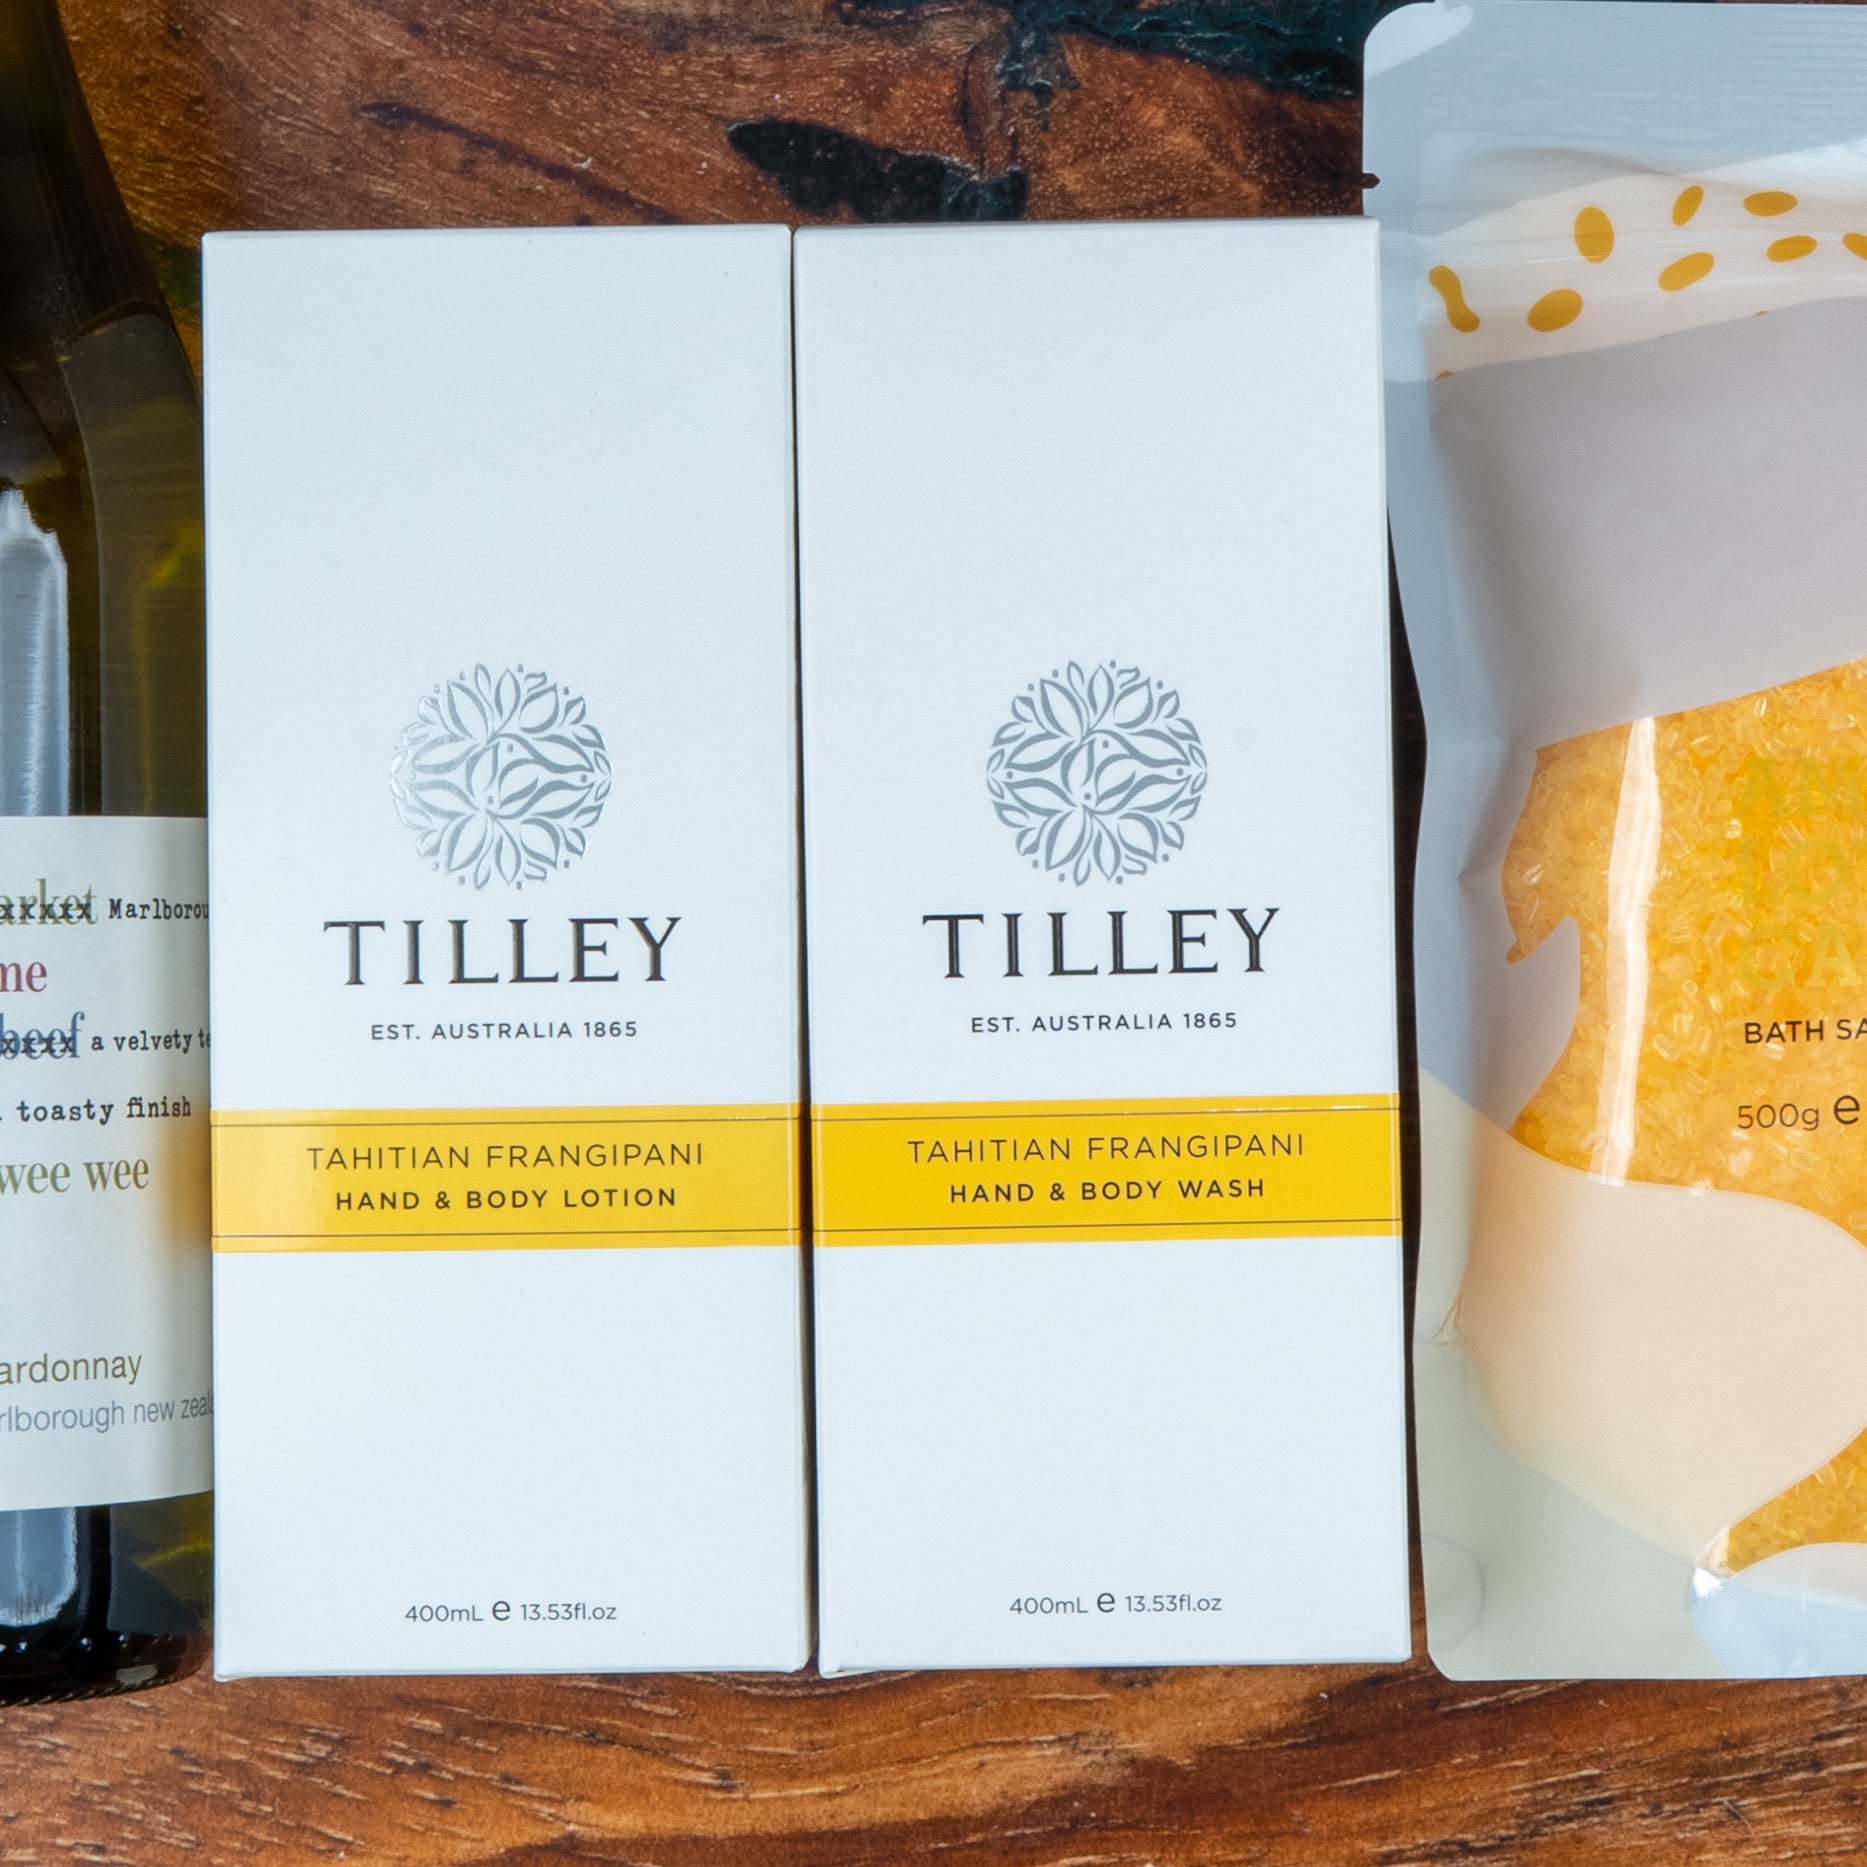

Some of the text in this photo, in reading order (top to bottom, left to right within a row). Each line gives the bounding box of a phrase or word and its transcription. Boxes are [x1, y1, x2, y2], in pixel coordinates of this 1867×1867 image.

[323, 916, 683, 986] TILLEY
[922, 907, 1281, 979] TILLEY
[371, 1021, 638, 1041] EST. AUSTRALIA 1865
[971, 1012, 1238, 1033] EST. AUSTRALIA 1865
[1744, 1019, 1824, 1044] BATH
[91, 1035, 105, 1051] a
[114, 1029, 193, 1055] velvety
[16, 1096, 192, 1126] toasty finish
[1736, 1103, 1820, 1131] 500g
[306, 1142, 703, 1171] TAHITIAN FRANGIPANI
[907, 1133, 1304, 1164] TAHITIAN FRANGIPANI
[83, 1159, 149, 1192] wee
[336, 1187, 676, 1211] HAND & BODY LOTION
[950, 1178, 1265, 1204] HAND & BODY WASH
[0, 1353, 143, 1386] ardonnay
[133, 1401, 176, 1425] new
[404, 1600, 618, 1623] 400mL e 13.53fl.oz
[1009, 1592, 1223, 1615] 400mL e 13.53fl.oz
